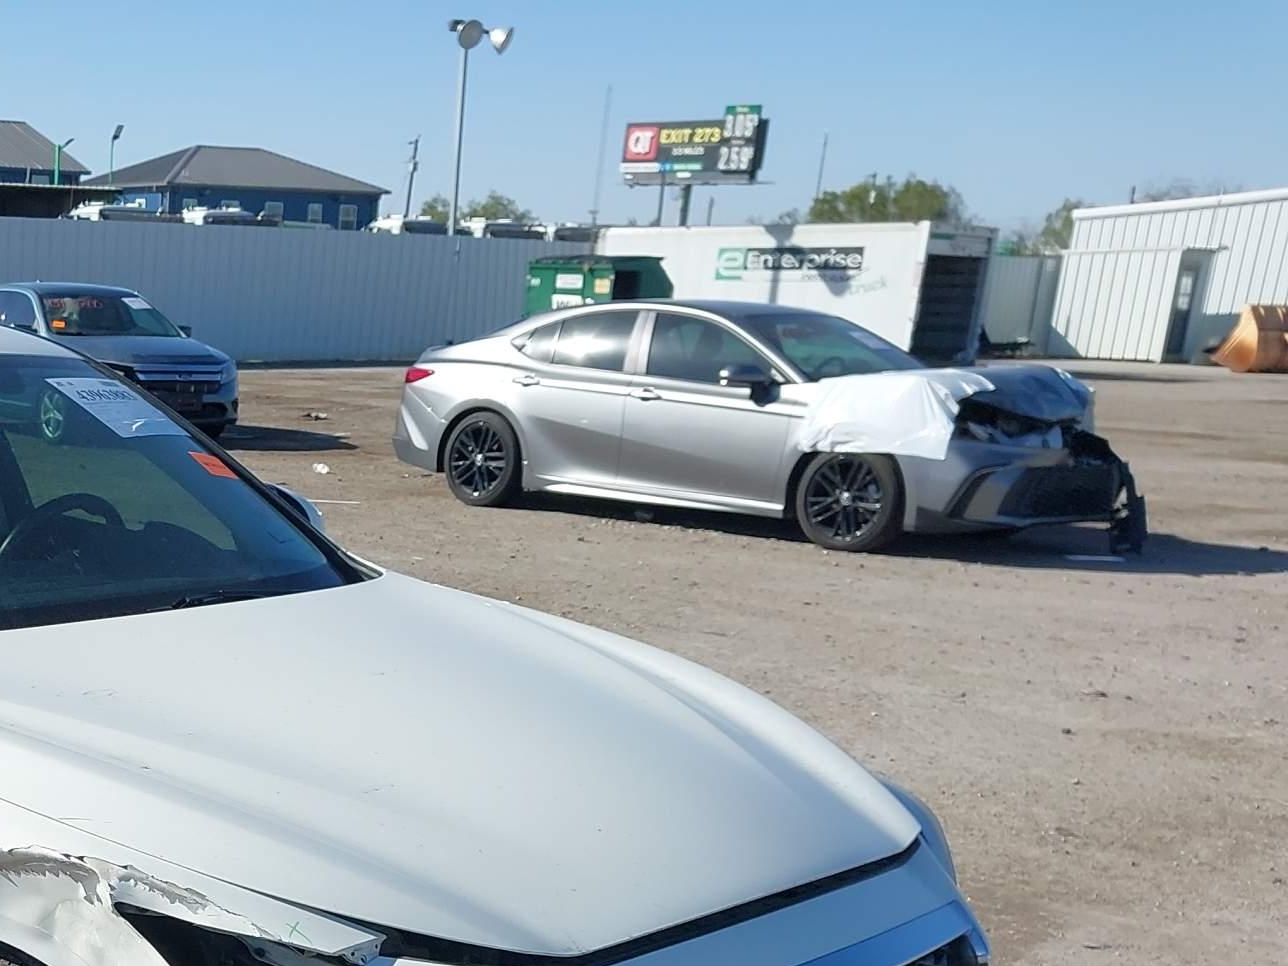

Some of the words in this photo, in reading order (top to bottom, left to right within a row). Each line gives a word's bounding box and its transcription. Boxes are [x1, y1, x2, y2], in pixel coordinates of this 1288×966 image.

[628, 131, 653, 154] QT
[659, 129, 692, 144] EXIT
[693, 127, 722, 143] 273
[746, 248, 863, 270] Enterprise
